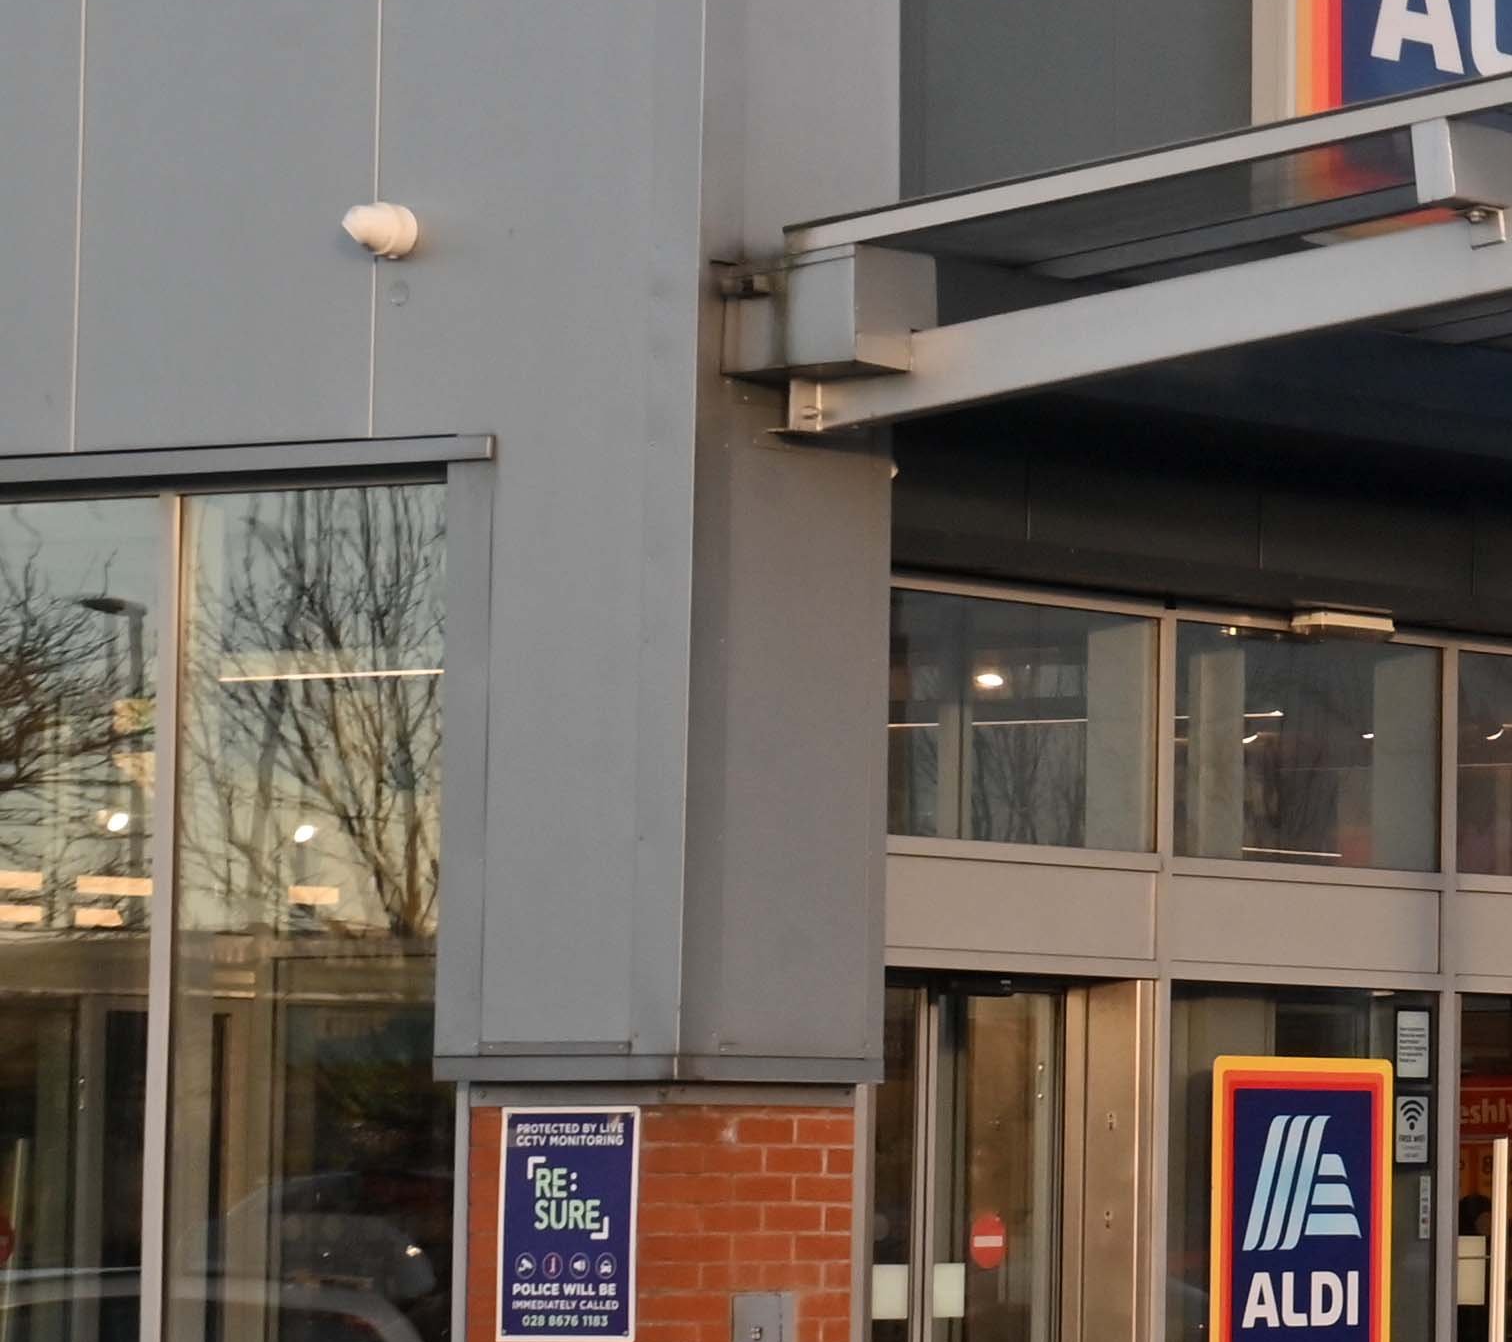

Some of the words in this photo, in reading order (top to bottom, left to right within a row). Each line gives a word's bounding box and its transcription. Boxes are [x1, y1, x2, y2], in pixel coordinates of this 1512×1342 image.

[516, 1123, 580, 1134] PROTECTED
[582, 1123, 597, 1134] BY
[600, 1123, 625, 1134] LIVE
[516, 1135, 547, 1147] CCTV
[549, 1135, 625, 1147] MONITORING
[535, 1168, 578, 1198] RE:
[534, 1199, 601, 1230] SURE
[512, 1283, 560, 1296] POLICE
[563, 1283, 596, 1296] WILL
[599, 1283, 617, 1296] BE
[1241, 1270, 1359, 1328] ALDI
[512, 1300, 577, 1310] IMMEDIATELY
[580, 1300, 619, 1311] CALLED
[522, 1315, 545, 1327] 028
[583, 1315, 608, 1327] 1183
